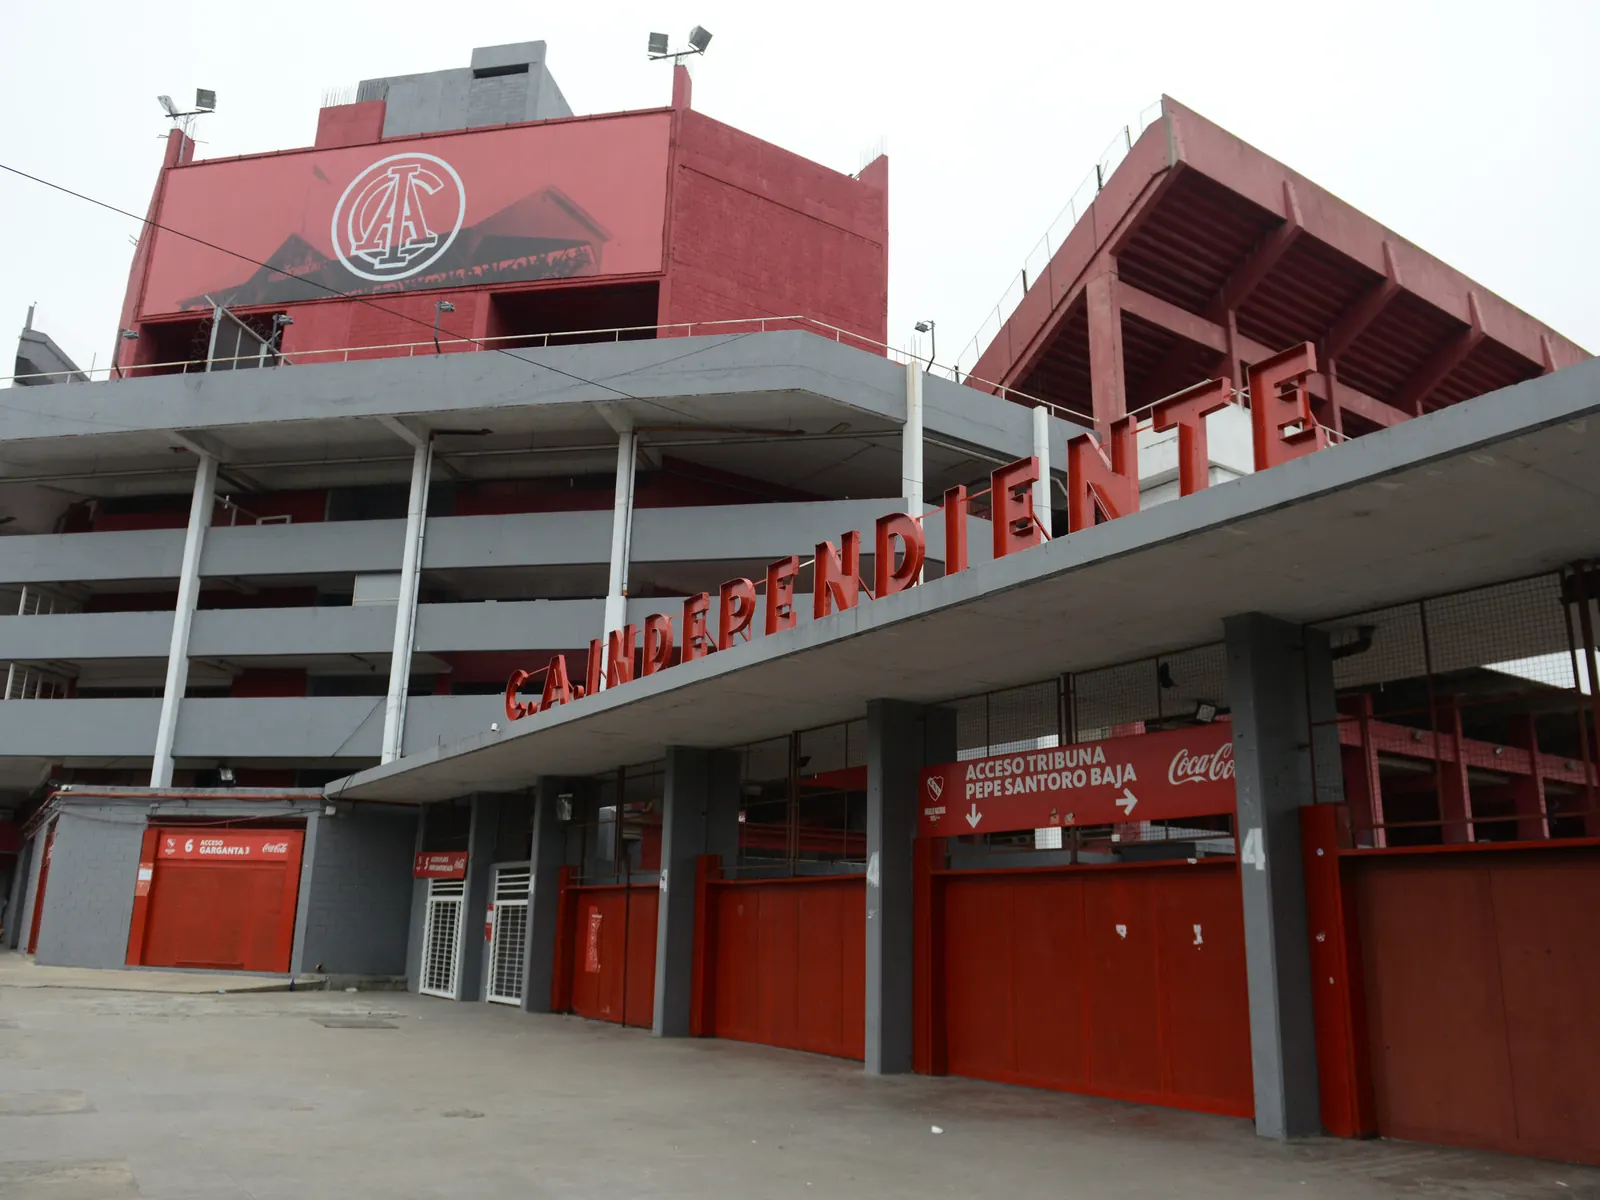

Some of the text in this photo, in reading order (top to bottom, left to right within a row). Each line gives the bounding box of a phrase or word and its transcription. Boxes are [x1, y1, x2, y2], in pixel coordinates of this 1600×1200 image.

[965, 746, 1106, 781] ACCESO TRIBUNA
[1168, 743, 1236, 785] Coca-Co
[966, 763, 1137, 800] PEPE SANTORO BAJA
[185, 839, 194, 852] 6
[199, 846, 244, 855] GARGANTA
